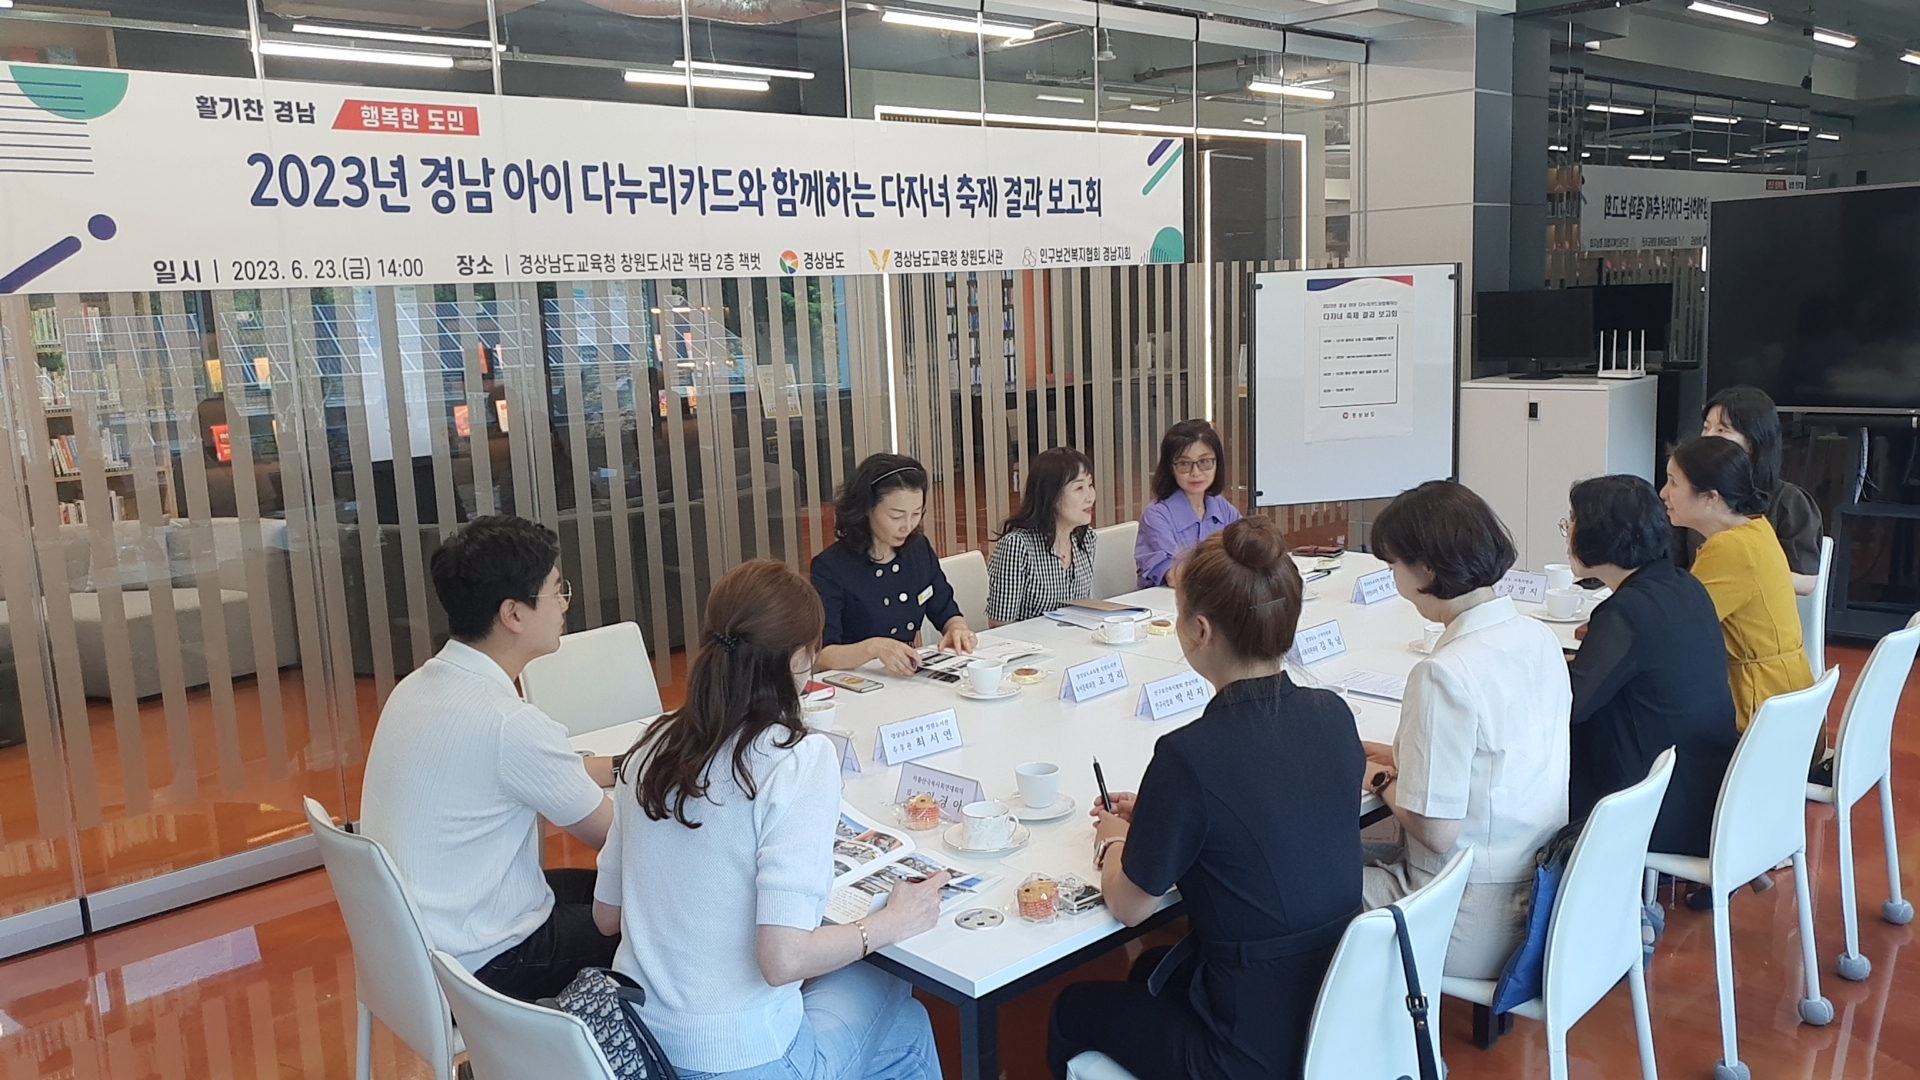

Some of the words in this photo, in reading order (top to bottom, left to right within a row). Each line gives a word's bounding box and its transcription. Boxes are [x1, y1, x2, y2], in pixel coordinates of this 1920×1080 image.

[195, 95, 264, 122] 활기찬
[273, 100, 316, 124] 경남
[360, 105, 419, 130] 행복한
[428, 109, 464, 132] 도민
[247, 152, 411, 213] 2023년
[421, 156, 495, 214] 경남
[502, 158, 573, 214] 아이
[581, 160, 766, 217] 다누리카드와
[770, 166, 876, 218] 함께하는
[880, 172, 950, 219] 다자녀
[955, 174, 999, 218] 축제
[1003, 175, 1043, 218] 결과
[1046, 176, 1103, 218] 보고회
[456, 254, 494, 276] 장소
[519, 253, 616, 275] 경상남도교육청
[620, 252, 684, 273] 창원도서관
[688, 252, 712, 272] 책담
[715, 252, 734, 271] 2층
[803, 251, 844, 270] 경상남도
[893, 249, 959, 268] 경상남도교육청
[960, 248, 1003, 266] 창원도서관
[1039, 247, 1101, 264] 인구보건복지협회
[1102, 246, 1131, 262] 경남지회
[153, 259, 202, 285] 일시
[232, 260, 285, 281] 2023.
[291, 260, 308, 279] 6.
[314, 257, 371, 281] 23.(금)
[377, 258, 424, 278] 14:00
